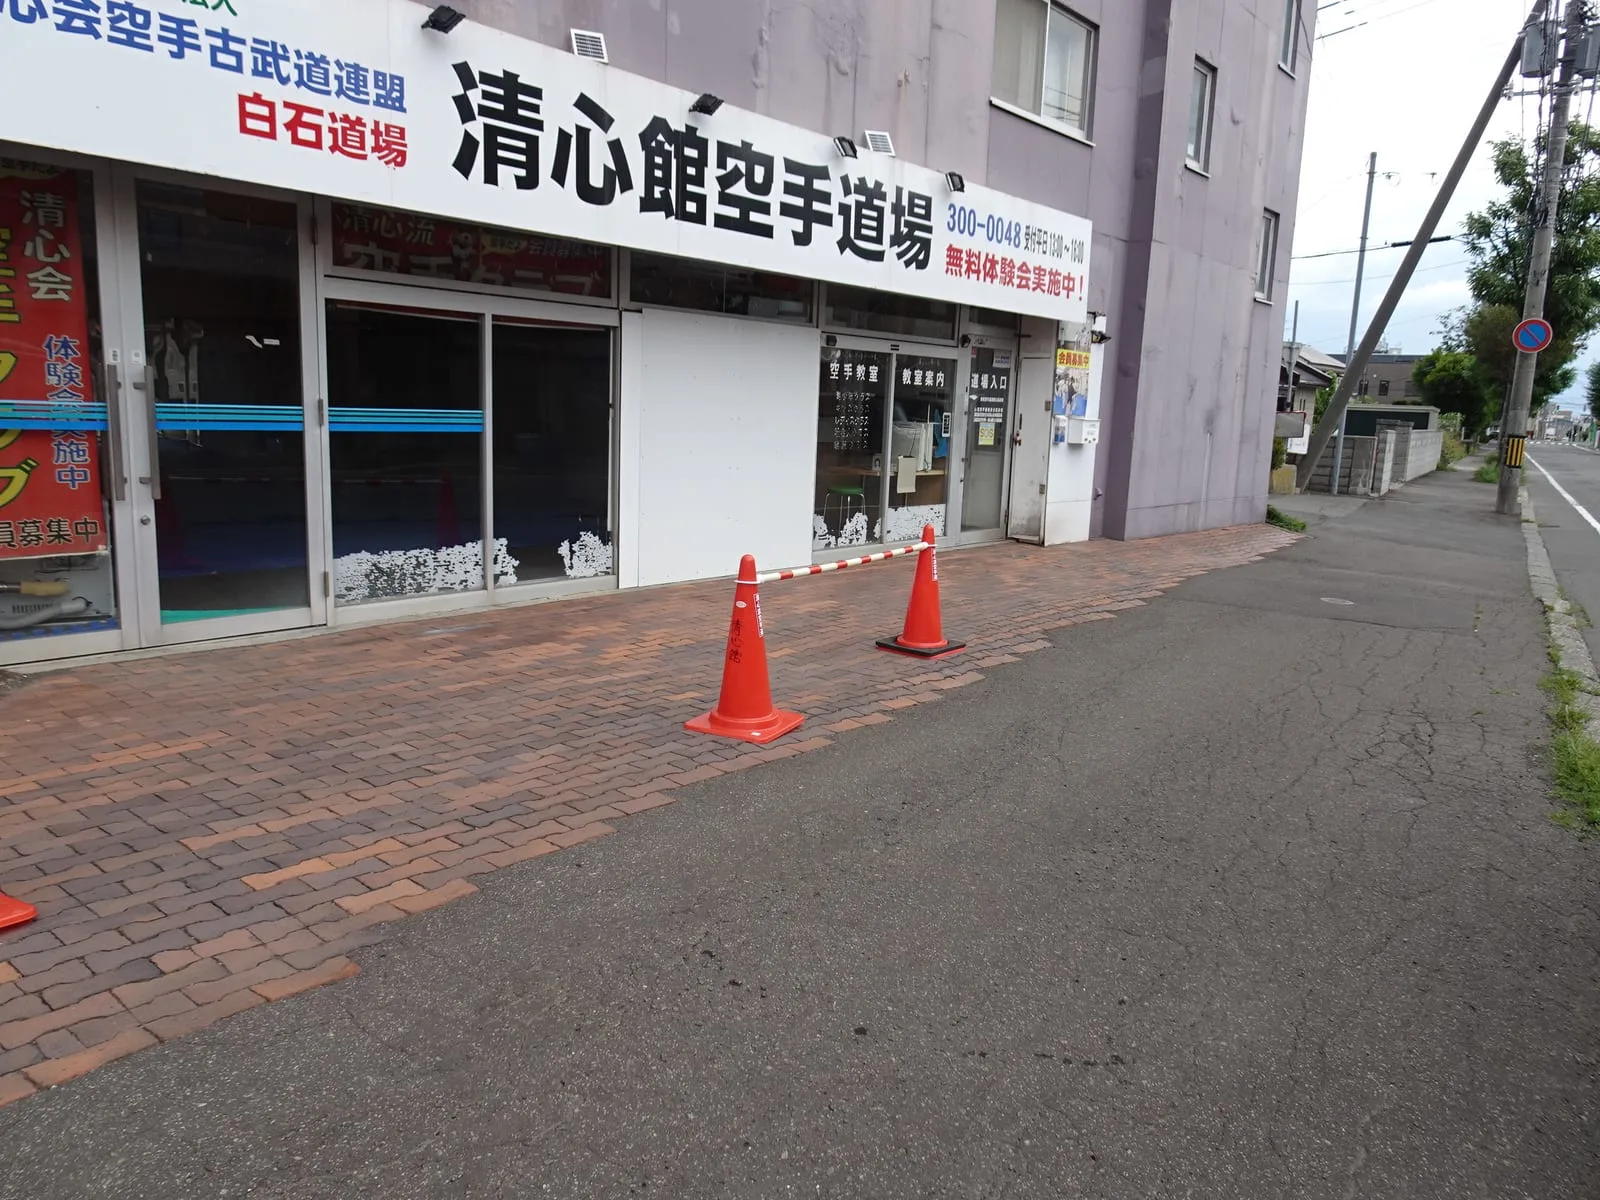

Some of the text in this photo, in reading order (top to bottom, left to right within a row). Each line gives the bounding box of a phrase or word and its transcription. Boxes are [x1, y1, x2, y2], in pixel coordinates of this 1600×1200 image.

[237, 91, 408, 169] 白石道場
[451, 60, 933, 271] 清心館空手道場
[20, 190, 73, 302] 清心会
[947, 203, 1021, 249] 300-0048
[945, 244, 1083, 301] 無料体験会実施中！
[829, 361, 878, 382] 空手教室
[902, 367, 945, 387] 教室案内
[970, 373, 1007, 389] 道場入口
